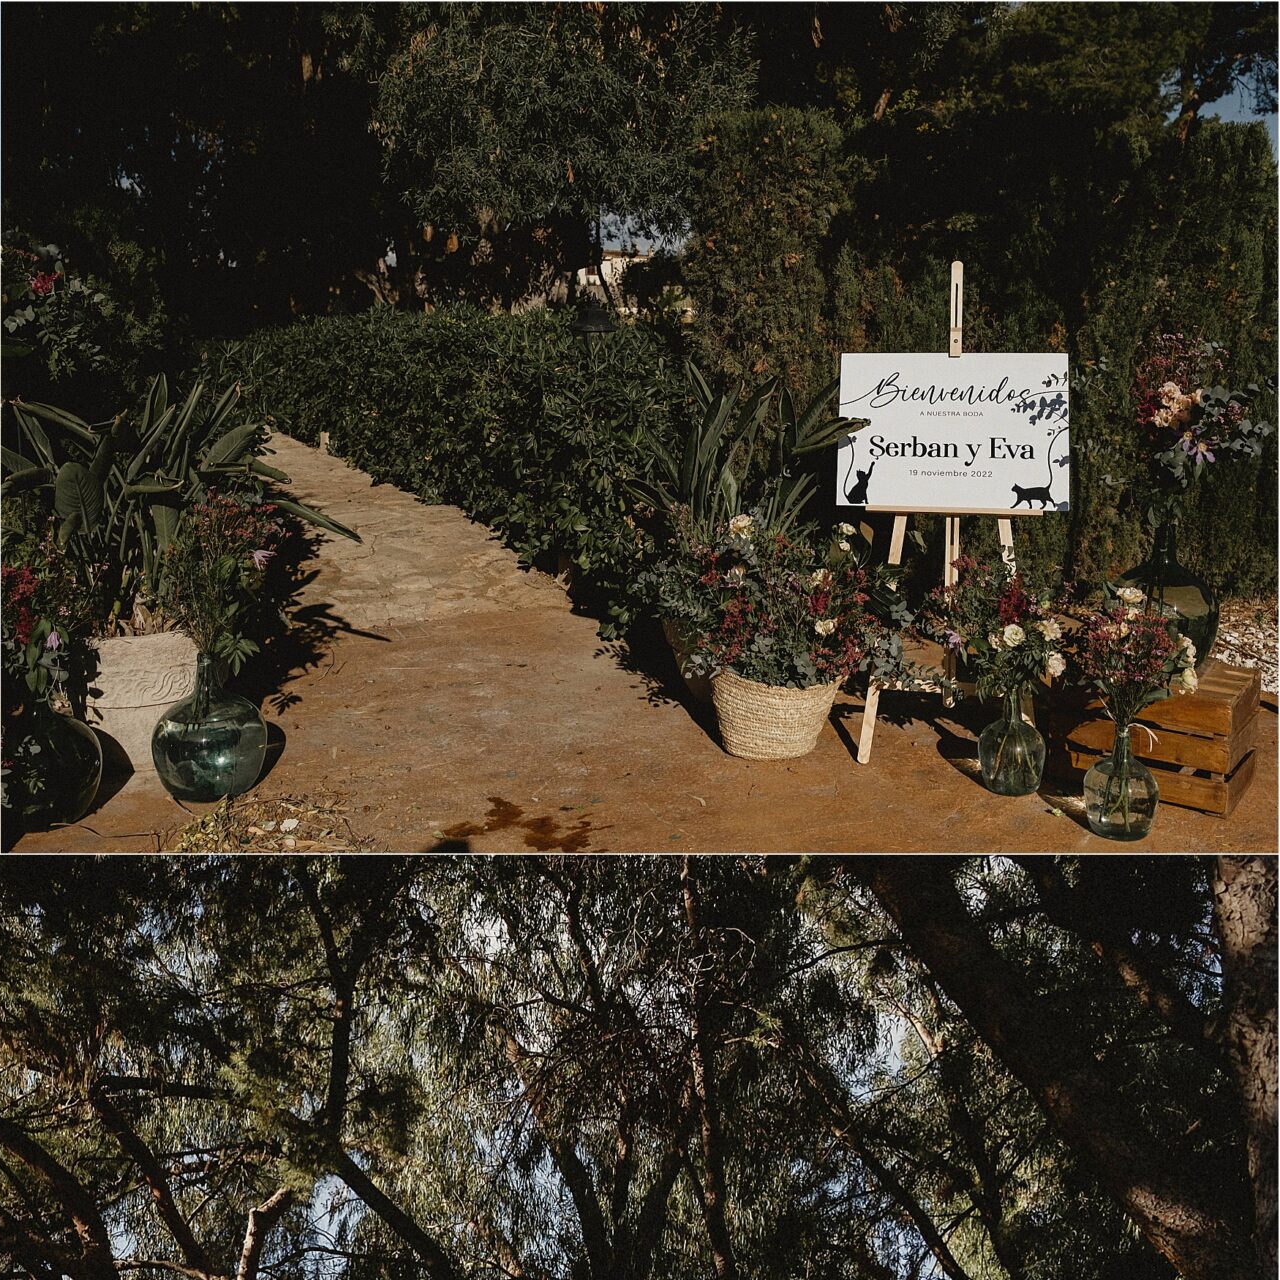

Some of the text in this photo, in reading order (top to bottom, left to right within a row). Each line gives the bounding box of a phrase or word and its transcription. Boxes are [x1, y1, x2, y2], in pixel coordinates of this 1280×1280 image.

[869, 372, 1032, 408] Bienvenidos
[965, 442, 982, 467] y
[989, 437, 1035, 460] Eva
[921, 469, 968, 477] noviembre
